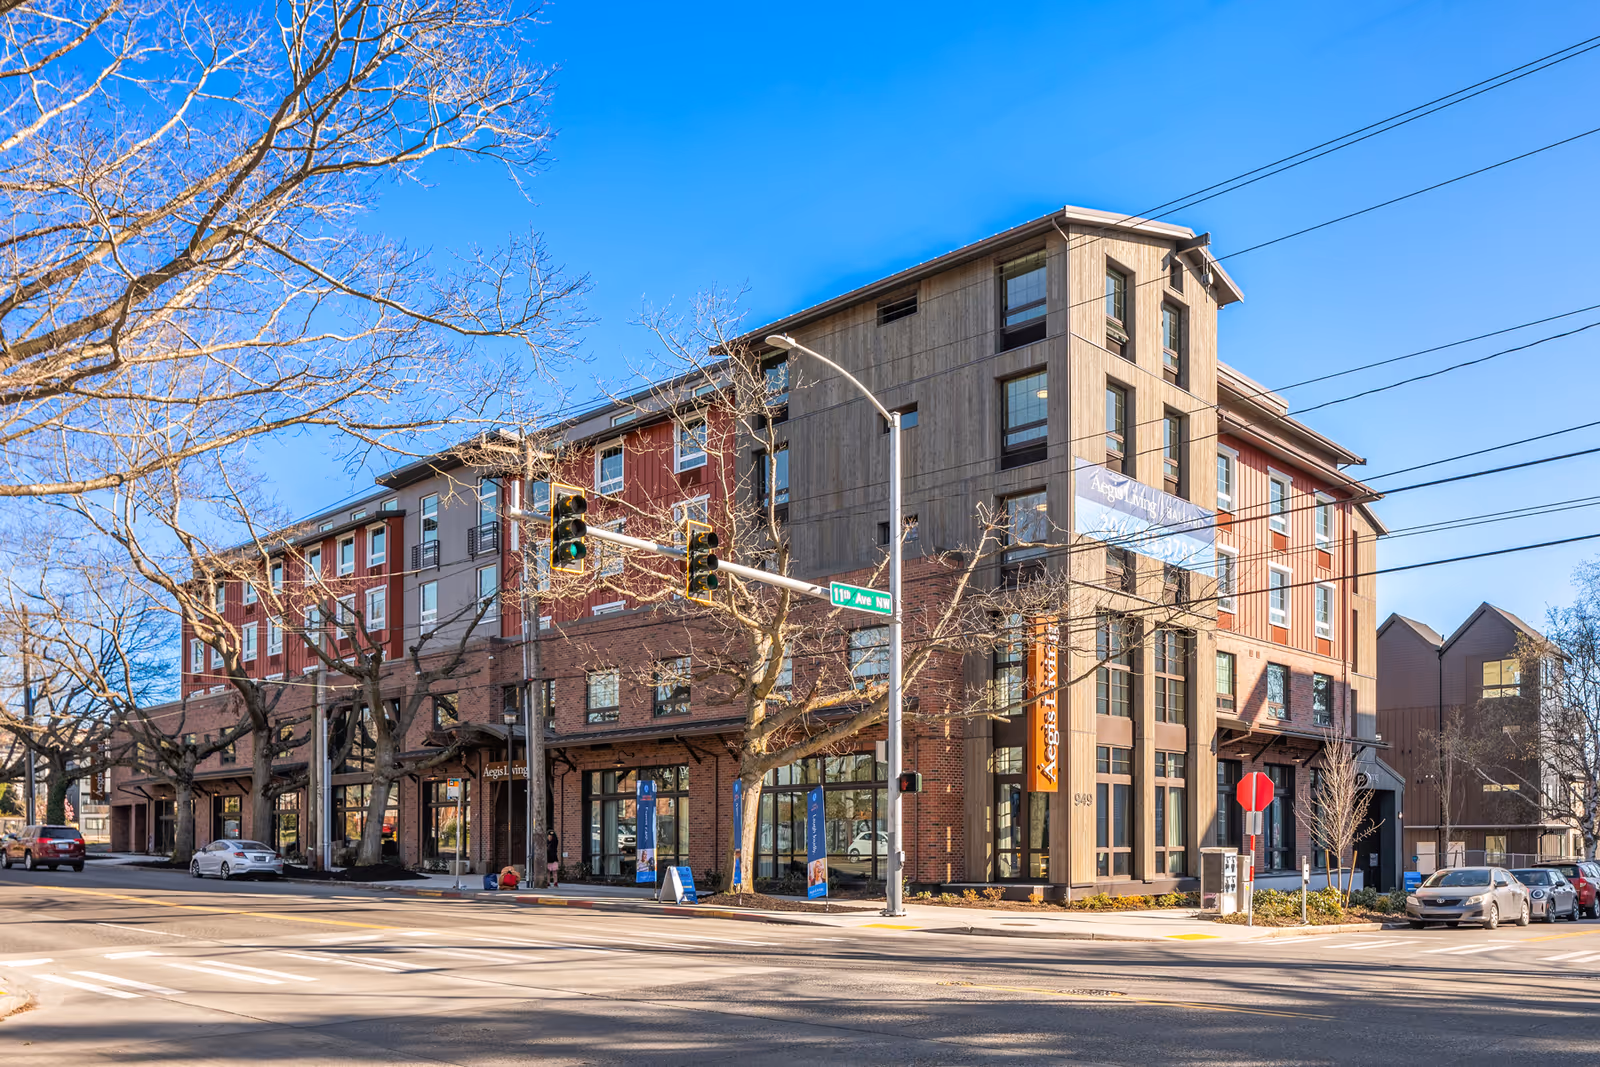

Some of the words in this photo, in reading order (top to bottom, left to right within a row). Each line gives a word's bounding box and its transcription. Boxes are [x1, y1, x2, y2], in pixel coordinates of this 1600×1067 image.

[834, 588, 851, 602] 11th
[855, 593, 872, 606] Ave
[876, 597, 891, 609] NW
[1044, 624, 1060, 708] Living
[504, 764, 528, 778] Lving
[1074, 793, 1093, 807] 949
